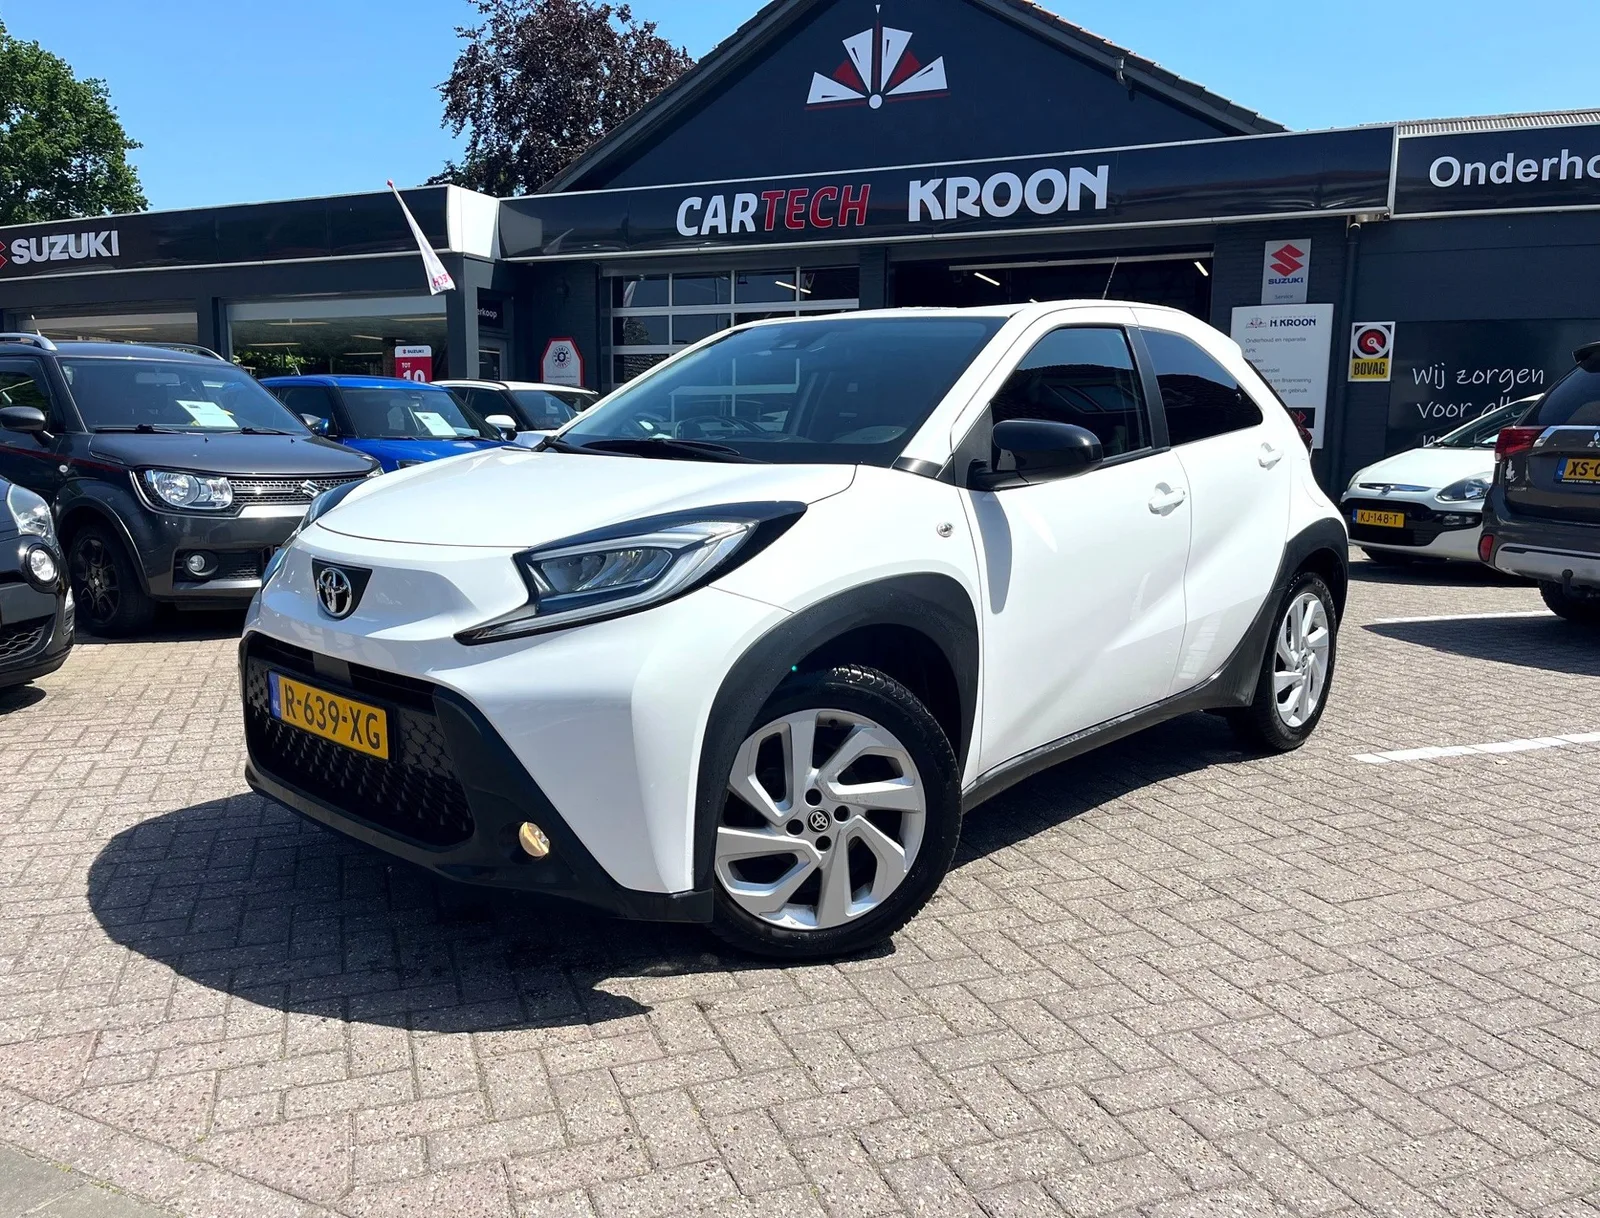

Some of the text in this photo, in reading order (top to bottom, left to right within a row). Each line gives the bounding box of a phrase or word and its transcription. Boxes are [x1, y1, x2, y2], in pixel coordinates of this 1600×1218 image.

[676, 165, 1110, 237] CARTECH KROON
[10, 230, 120, 265] SUZUKI
[1268, 277, 1304, 285] SUZUKI
[1354, 361, 1386, 376] BOVAG
[1456, 367, 1545, 393] zorgen
[1416, 401, 1473, 419] voor
[1360, 511, 1399, 525] KJ-148-T
[284, 683, 381, 750] R-639-XG
